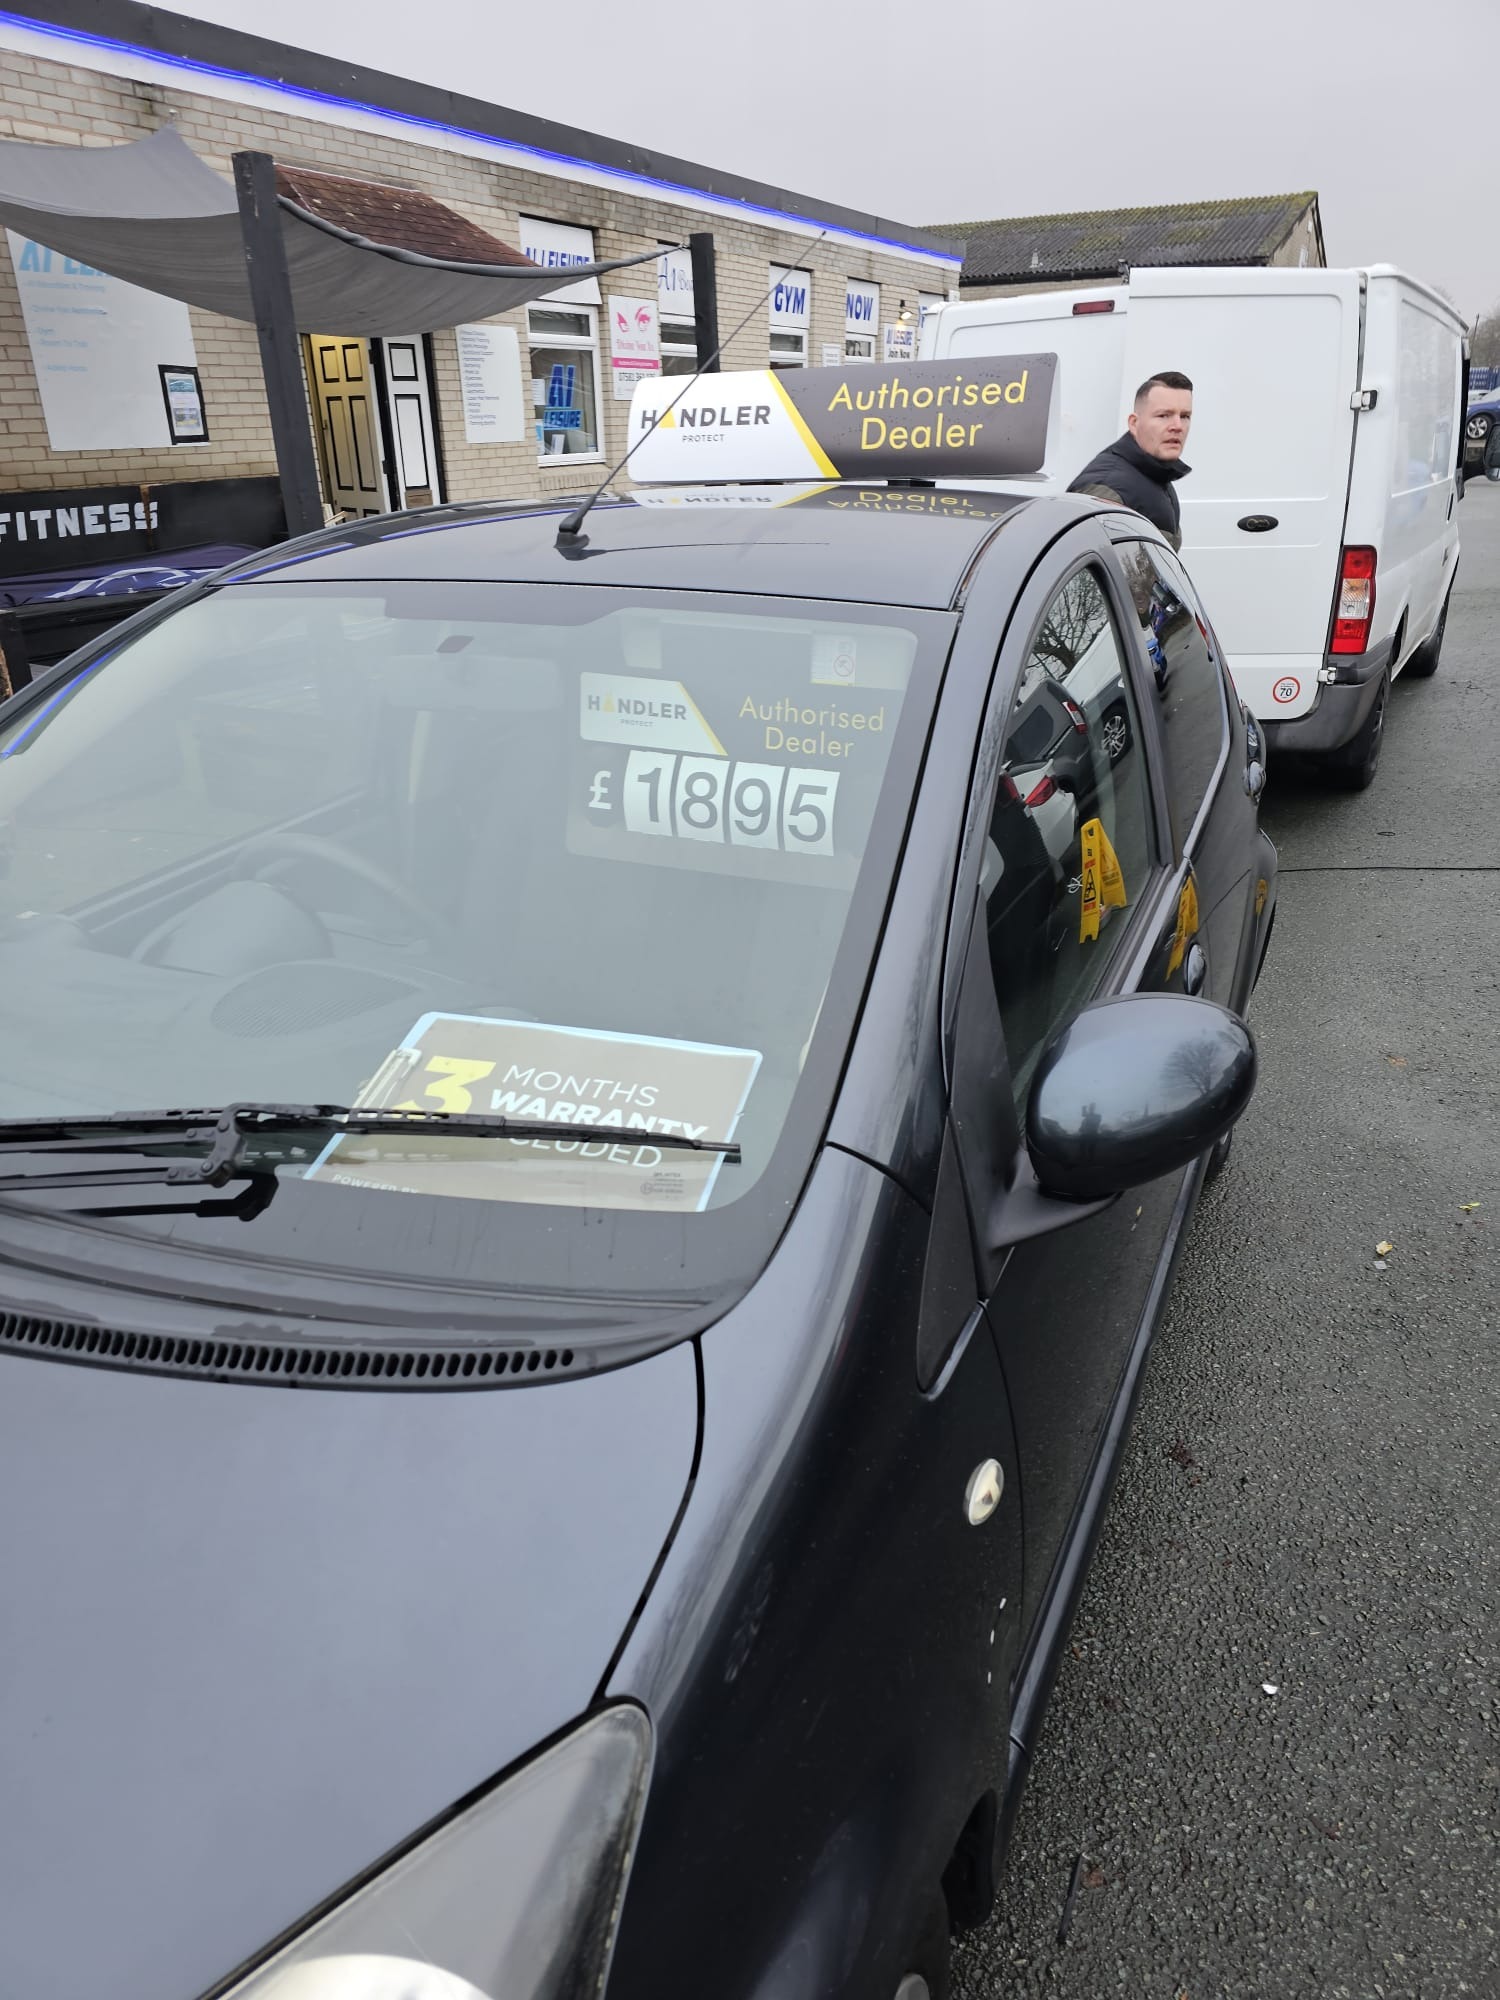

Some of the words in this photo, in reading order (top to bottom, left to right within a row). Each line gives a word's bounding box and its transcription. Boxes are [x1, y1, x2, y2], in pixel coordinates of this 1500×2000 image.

[774, 282, 806, 315] GYM
[846, 293, 873, 321] NOW
[828, 369, 1029, 412] Authorised
[682, 433, 726, 443] PROTECT
[860, 412, 984, 451] Dealer
[1280, 687, 1293, 697] 70
[620, 718, 654, 728] PROTECT
[738, 696, 885, 732] Authorised
[765, 726, 855, 758] Dealer
[588, 770, 612, 810] £
[636, 767, 829, 843] 1895
[391, 1055, 496, 1119] 3
[501, 1064, 660, 1107] MONTHS
[489, 1089, 709, 1140] WARRANTY
